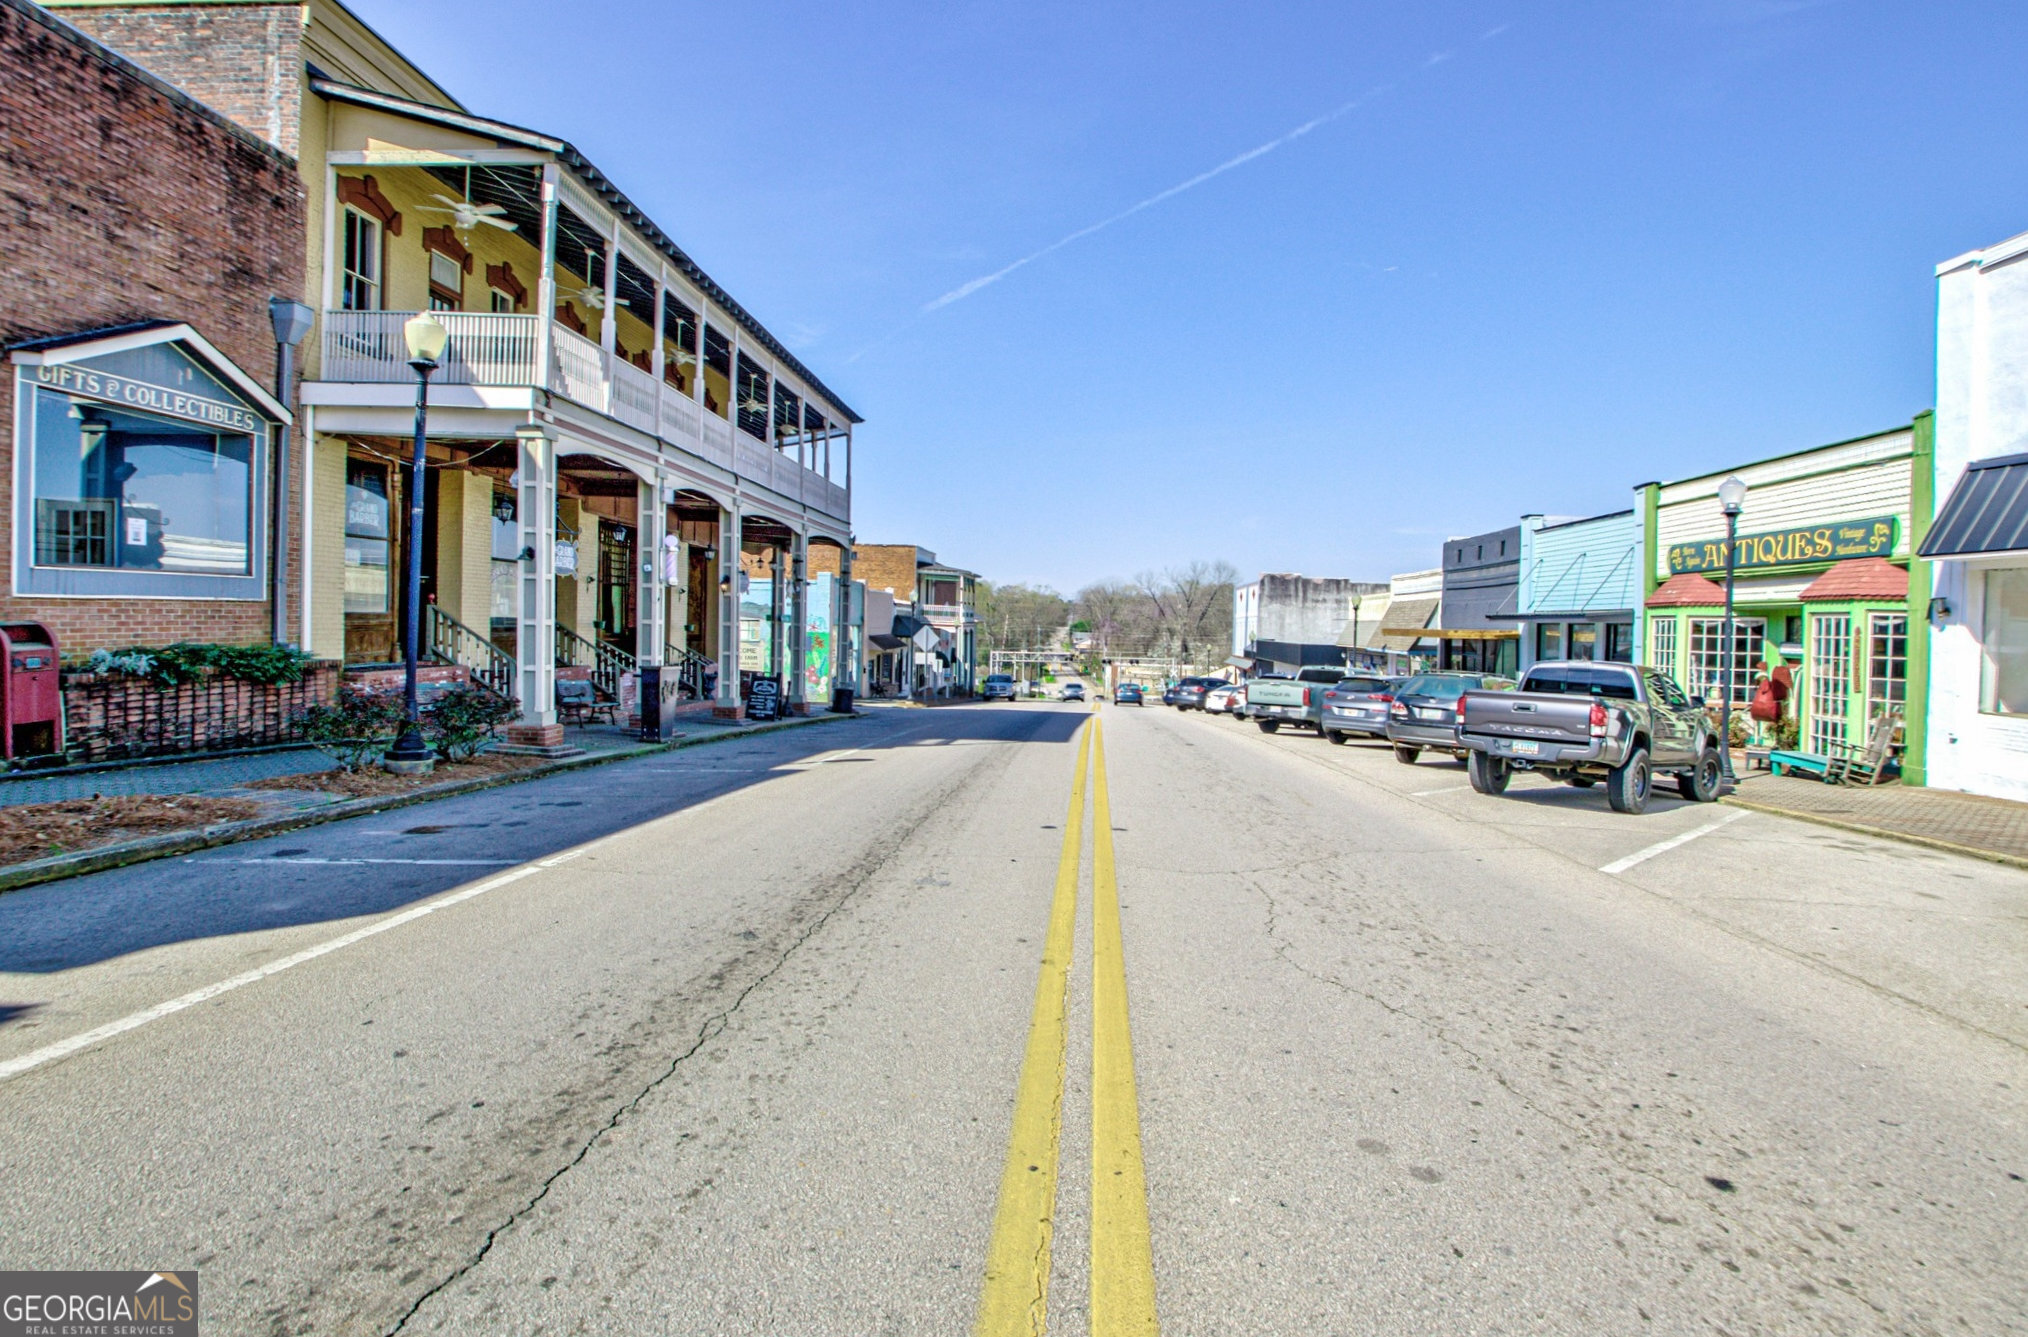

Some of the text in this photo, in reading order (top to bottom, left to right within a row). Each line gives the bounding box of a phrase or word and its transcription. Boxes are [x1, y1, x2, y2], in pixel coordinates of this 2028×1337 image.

[37, 365, 100, 394] GIFTS
[123, 384, 255, 430] COLLECTIBLES
[1702, 529, 1833, 569] ANTIQUES
[1489, 723, 1562, 736] TACOMA
